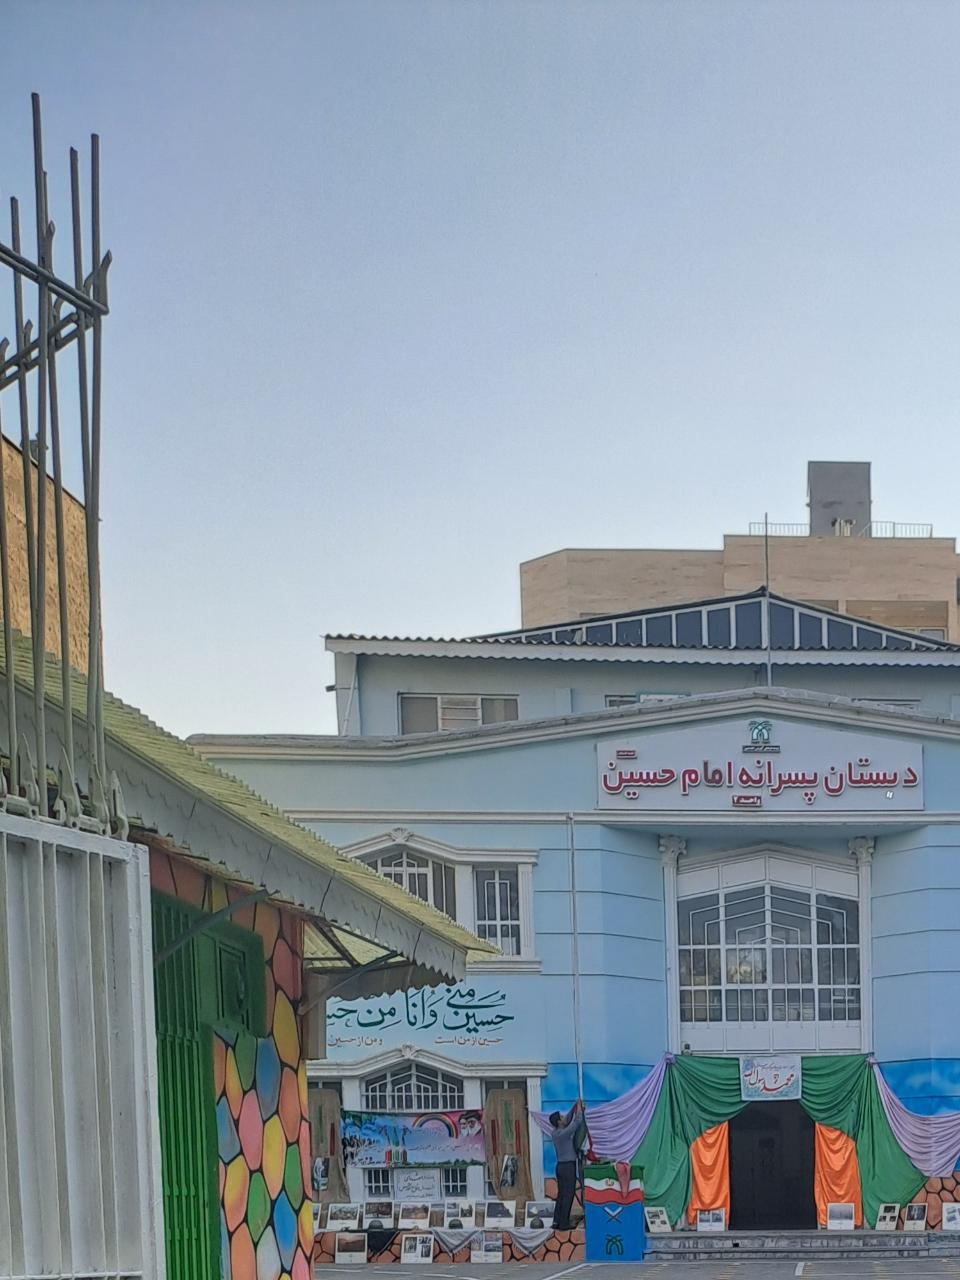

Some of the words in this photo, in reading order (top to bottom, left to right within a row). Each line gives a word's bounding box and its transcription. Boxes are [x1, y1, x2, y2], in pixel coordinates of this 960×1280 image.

[601, 760, 677, 800] حسین
[680, 760, 734, 797] امام
[736, 759, 820, 804] پسرانه
[824, 757, 919, 800] دبستان
[478, 1036, 503, 1046] حسین
